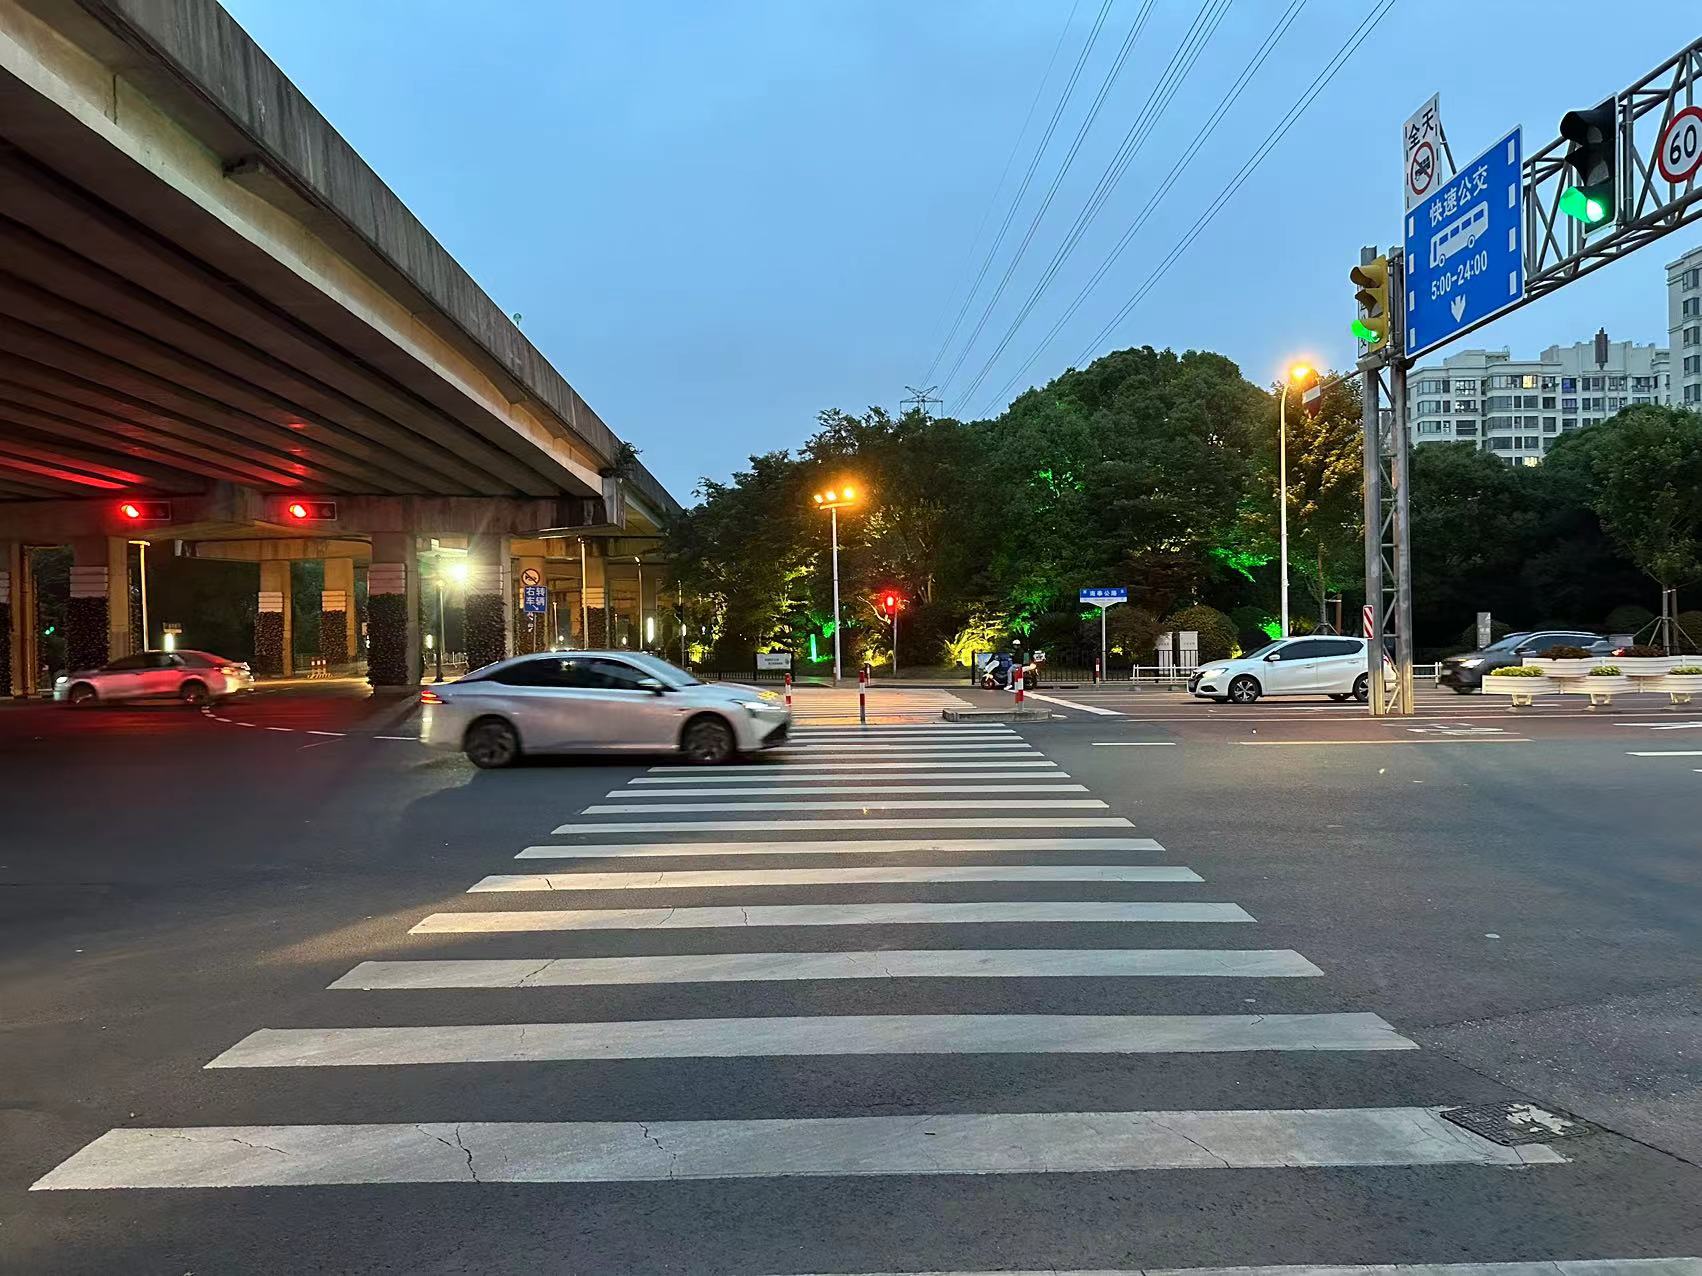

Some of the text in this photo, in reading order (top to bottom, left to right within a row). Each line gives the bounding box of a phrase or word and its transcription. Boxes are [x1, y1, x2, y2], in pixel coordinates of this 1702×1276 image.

[1408, 107, 1434, 151] 全天
[1670, 124, 1697, 165] 60
[1429, 165, 1488, 228] 快速公交
[1431, 250, 1487, 301] 5:00-24:00
[526, 587, 545, 596] 右转
[526, 597, 545, 606] 车辆
